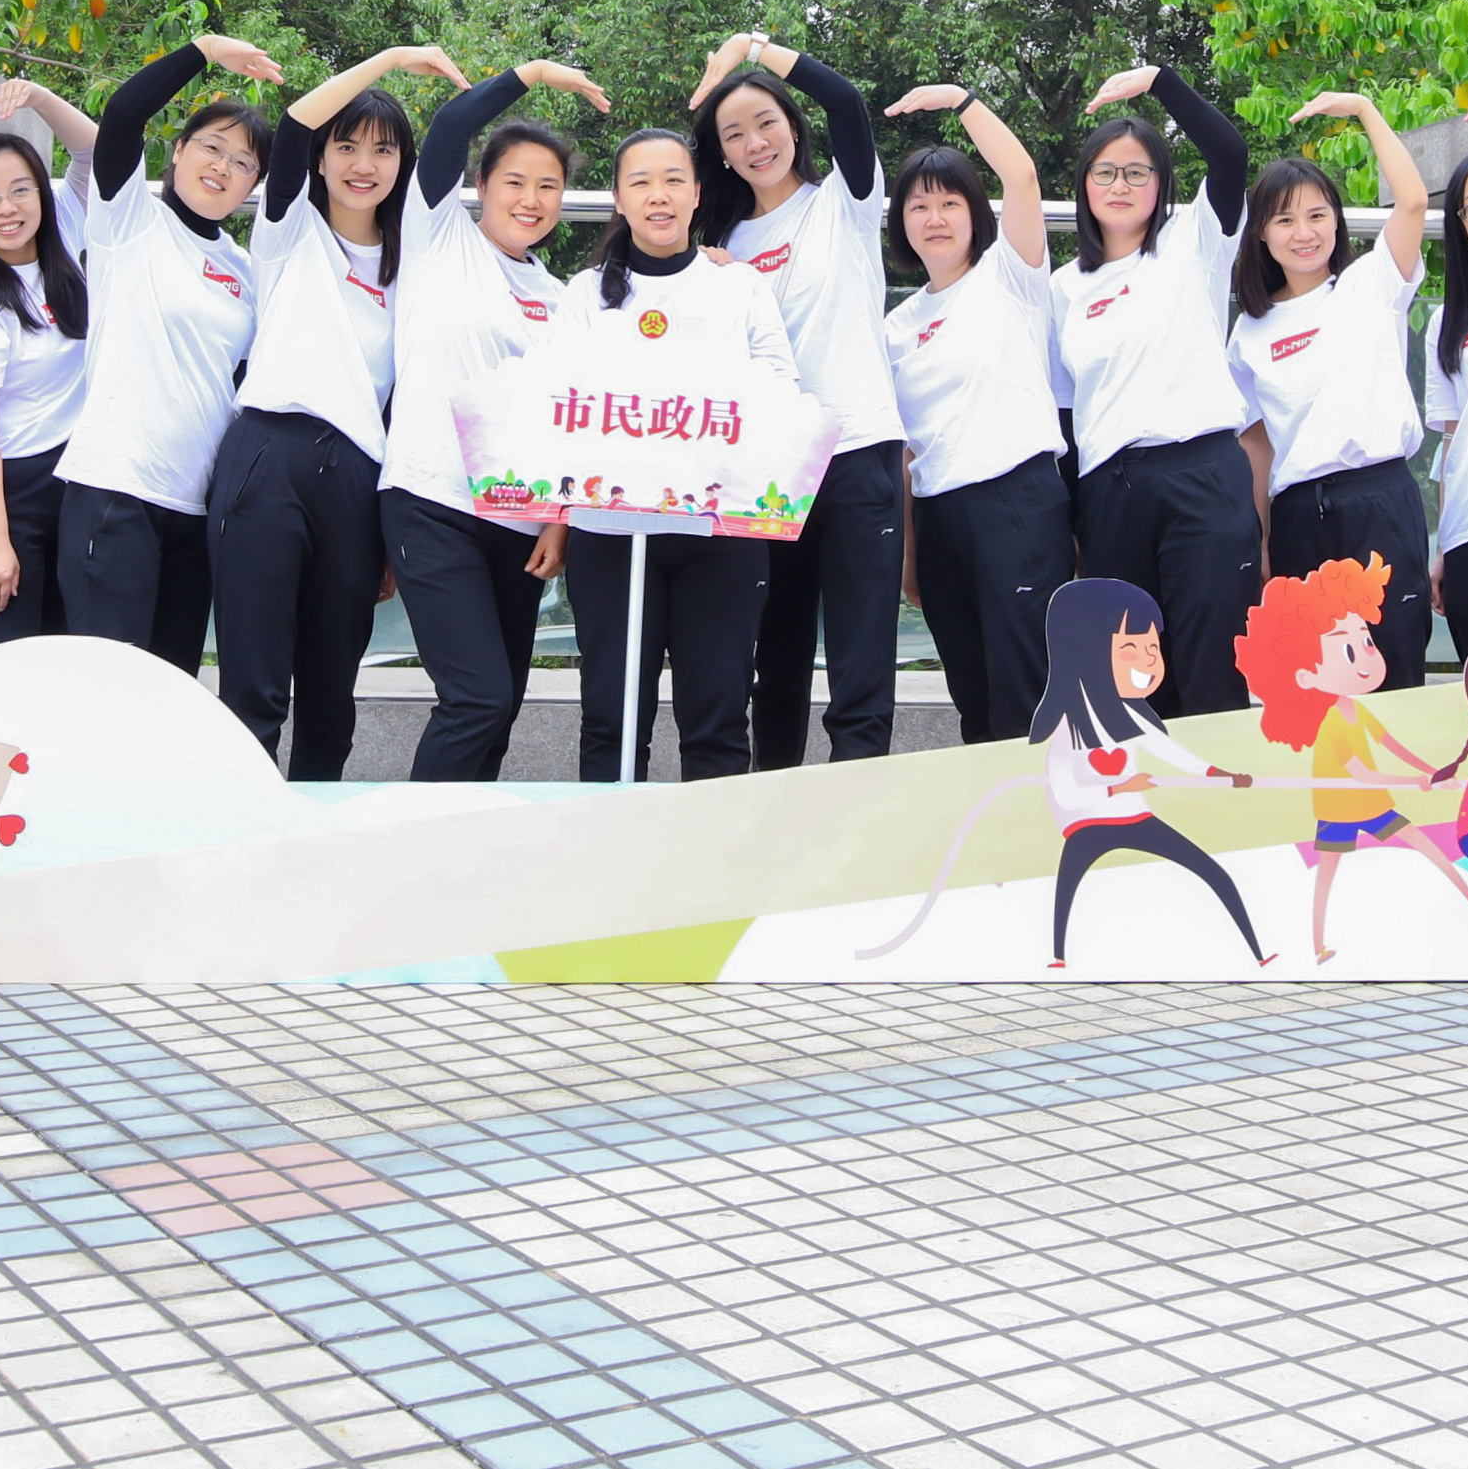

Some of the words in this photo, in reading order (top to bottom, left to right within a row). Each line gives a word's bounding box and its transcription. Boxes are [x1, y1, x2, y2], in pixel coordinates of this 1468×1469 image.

[1272, 335, 1315, 358] LI-NIN
[551, 387, 742, 445] 市民政局
